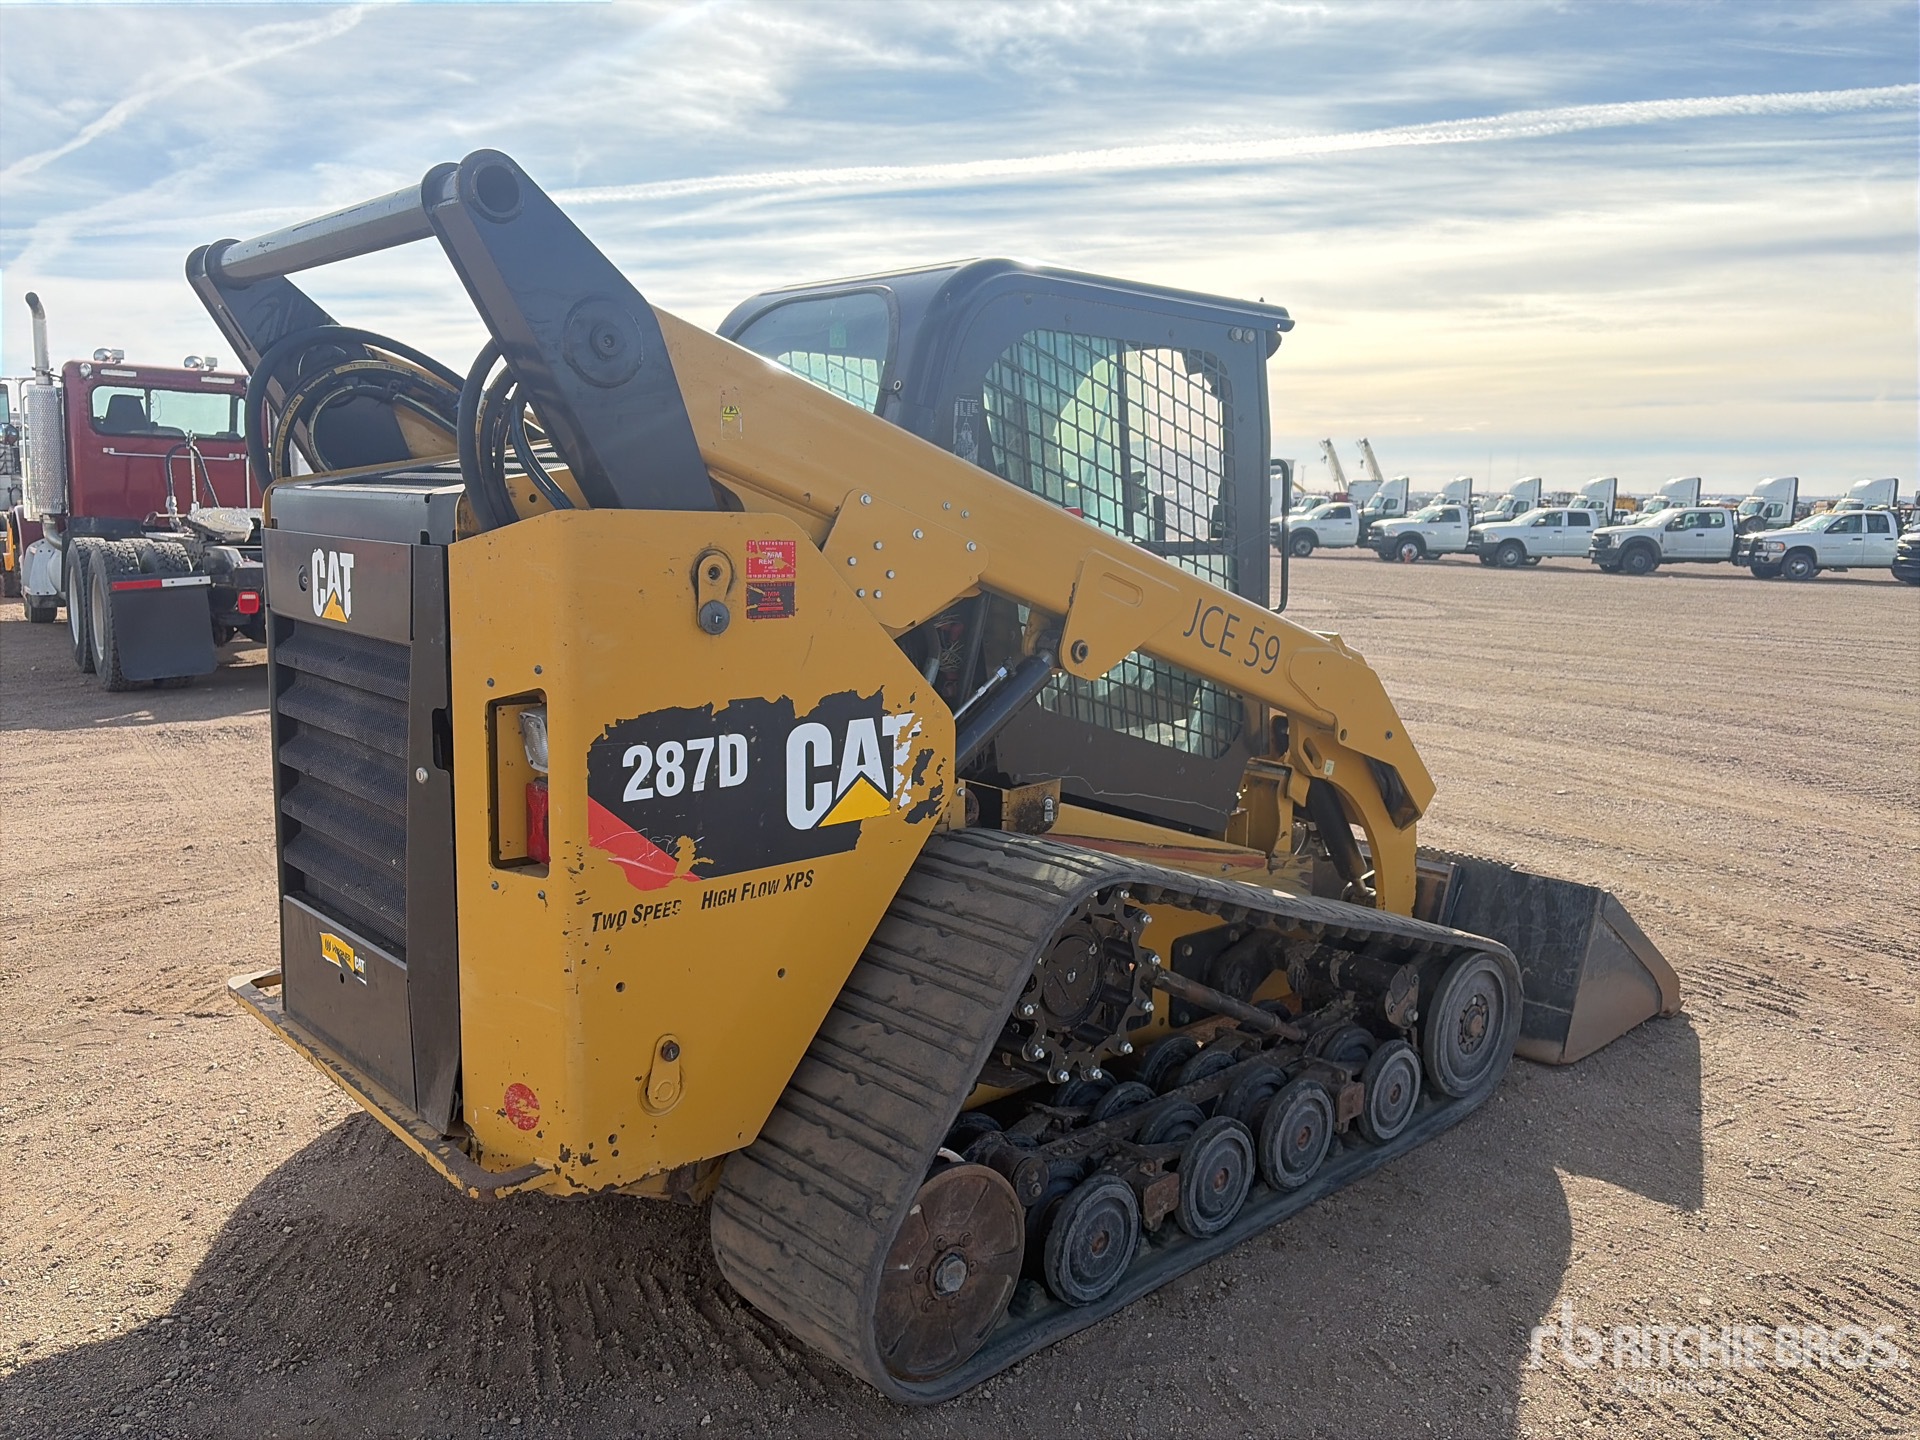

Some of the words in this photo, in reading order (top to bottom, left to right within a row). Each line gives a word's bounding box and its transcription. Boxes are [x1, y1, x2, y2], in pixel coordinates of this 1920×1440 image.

[312, 548, 354, 621] CAT
[1182, 598, 1241, 658] JCE
[1243, 625, 1281, 675] 59
[622, 733, 749, 803] 287D
[786, 712, 923, 831] CAT
[592, 910, 628, 933] TWO
[701, 888, 738, 910] HIGH
[741, 878, 780, 902] FLOW
[783, 869, 815, 892] XPS
